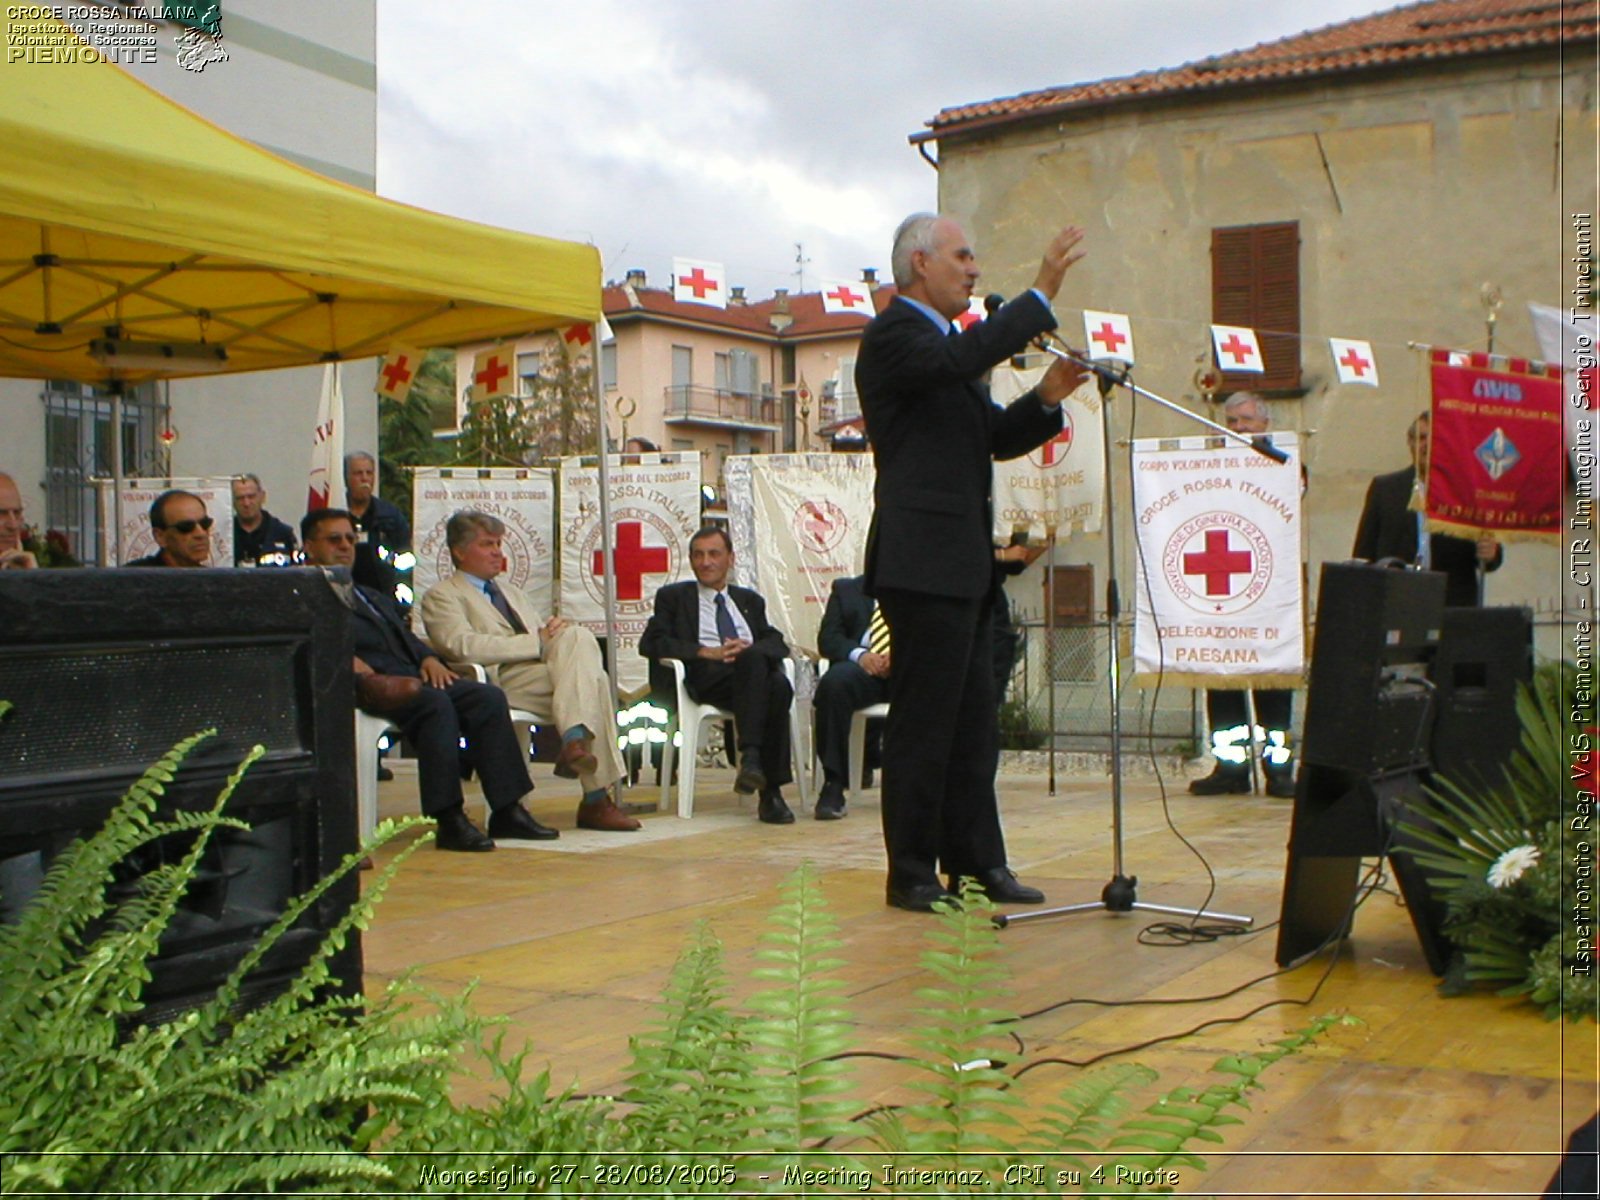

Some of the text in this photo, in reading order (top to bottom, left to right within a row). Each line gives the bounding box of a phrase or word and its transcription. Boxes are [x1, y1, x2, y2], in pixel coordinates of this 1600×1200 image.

[1139, 460, 1168, 471] CORPO
[1173, 458, 1221, 470] VOLONTARI
[1224, 457, 1240, 468] DEL
[607, 485, 644, 502] OSSA
[648, 489, 695, 538] ITALIANA
[1140, 477, 1295, 526] CROCE ROSSA ITALIANA
[461, 502, 502, 514] OSSA
[503, 506, 548, 557] ITALIANA
[1184, 524, 1195, 537] DI
[1194, 513, 1243, 532] GINEVRA
[1242, 521, 1257, 538] 22
[1252, 534, 1272, 578] AGOSTO
[1159, 625, 1280, 640] DELEGAZIONE DI
[1175, 647, 1259, 663] PAESANA
